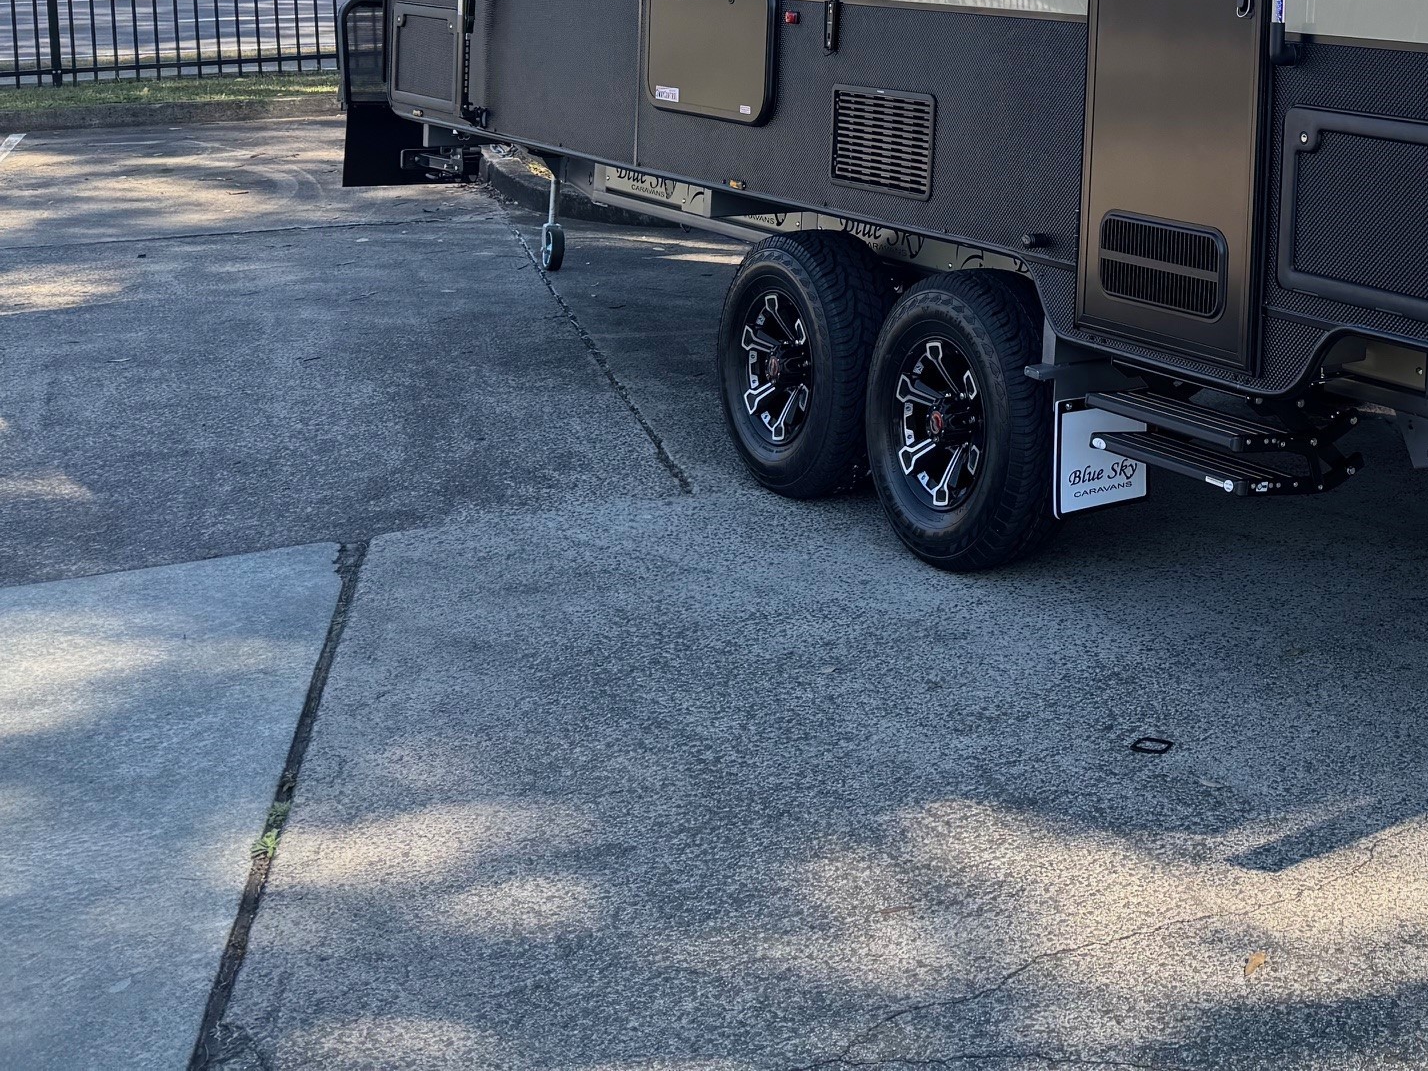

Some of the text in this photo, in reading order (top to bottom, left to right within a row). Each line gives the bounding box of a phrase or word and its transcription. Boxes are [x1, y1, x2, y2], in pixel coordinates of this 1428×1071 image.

[631, 183, 665, 198] CARAVANS
[867, 241, 908, 257] ARAVANS
[1068, 458, 1138, 486] Blue Sky
[1073, 480, 1133, 498] CARAVANS
